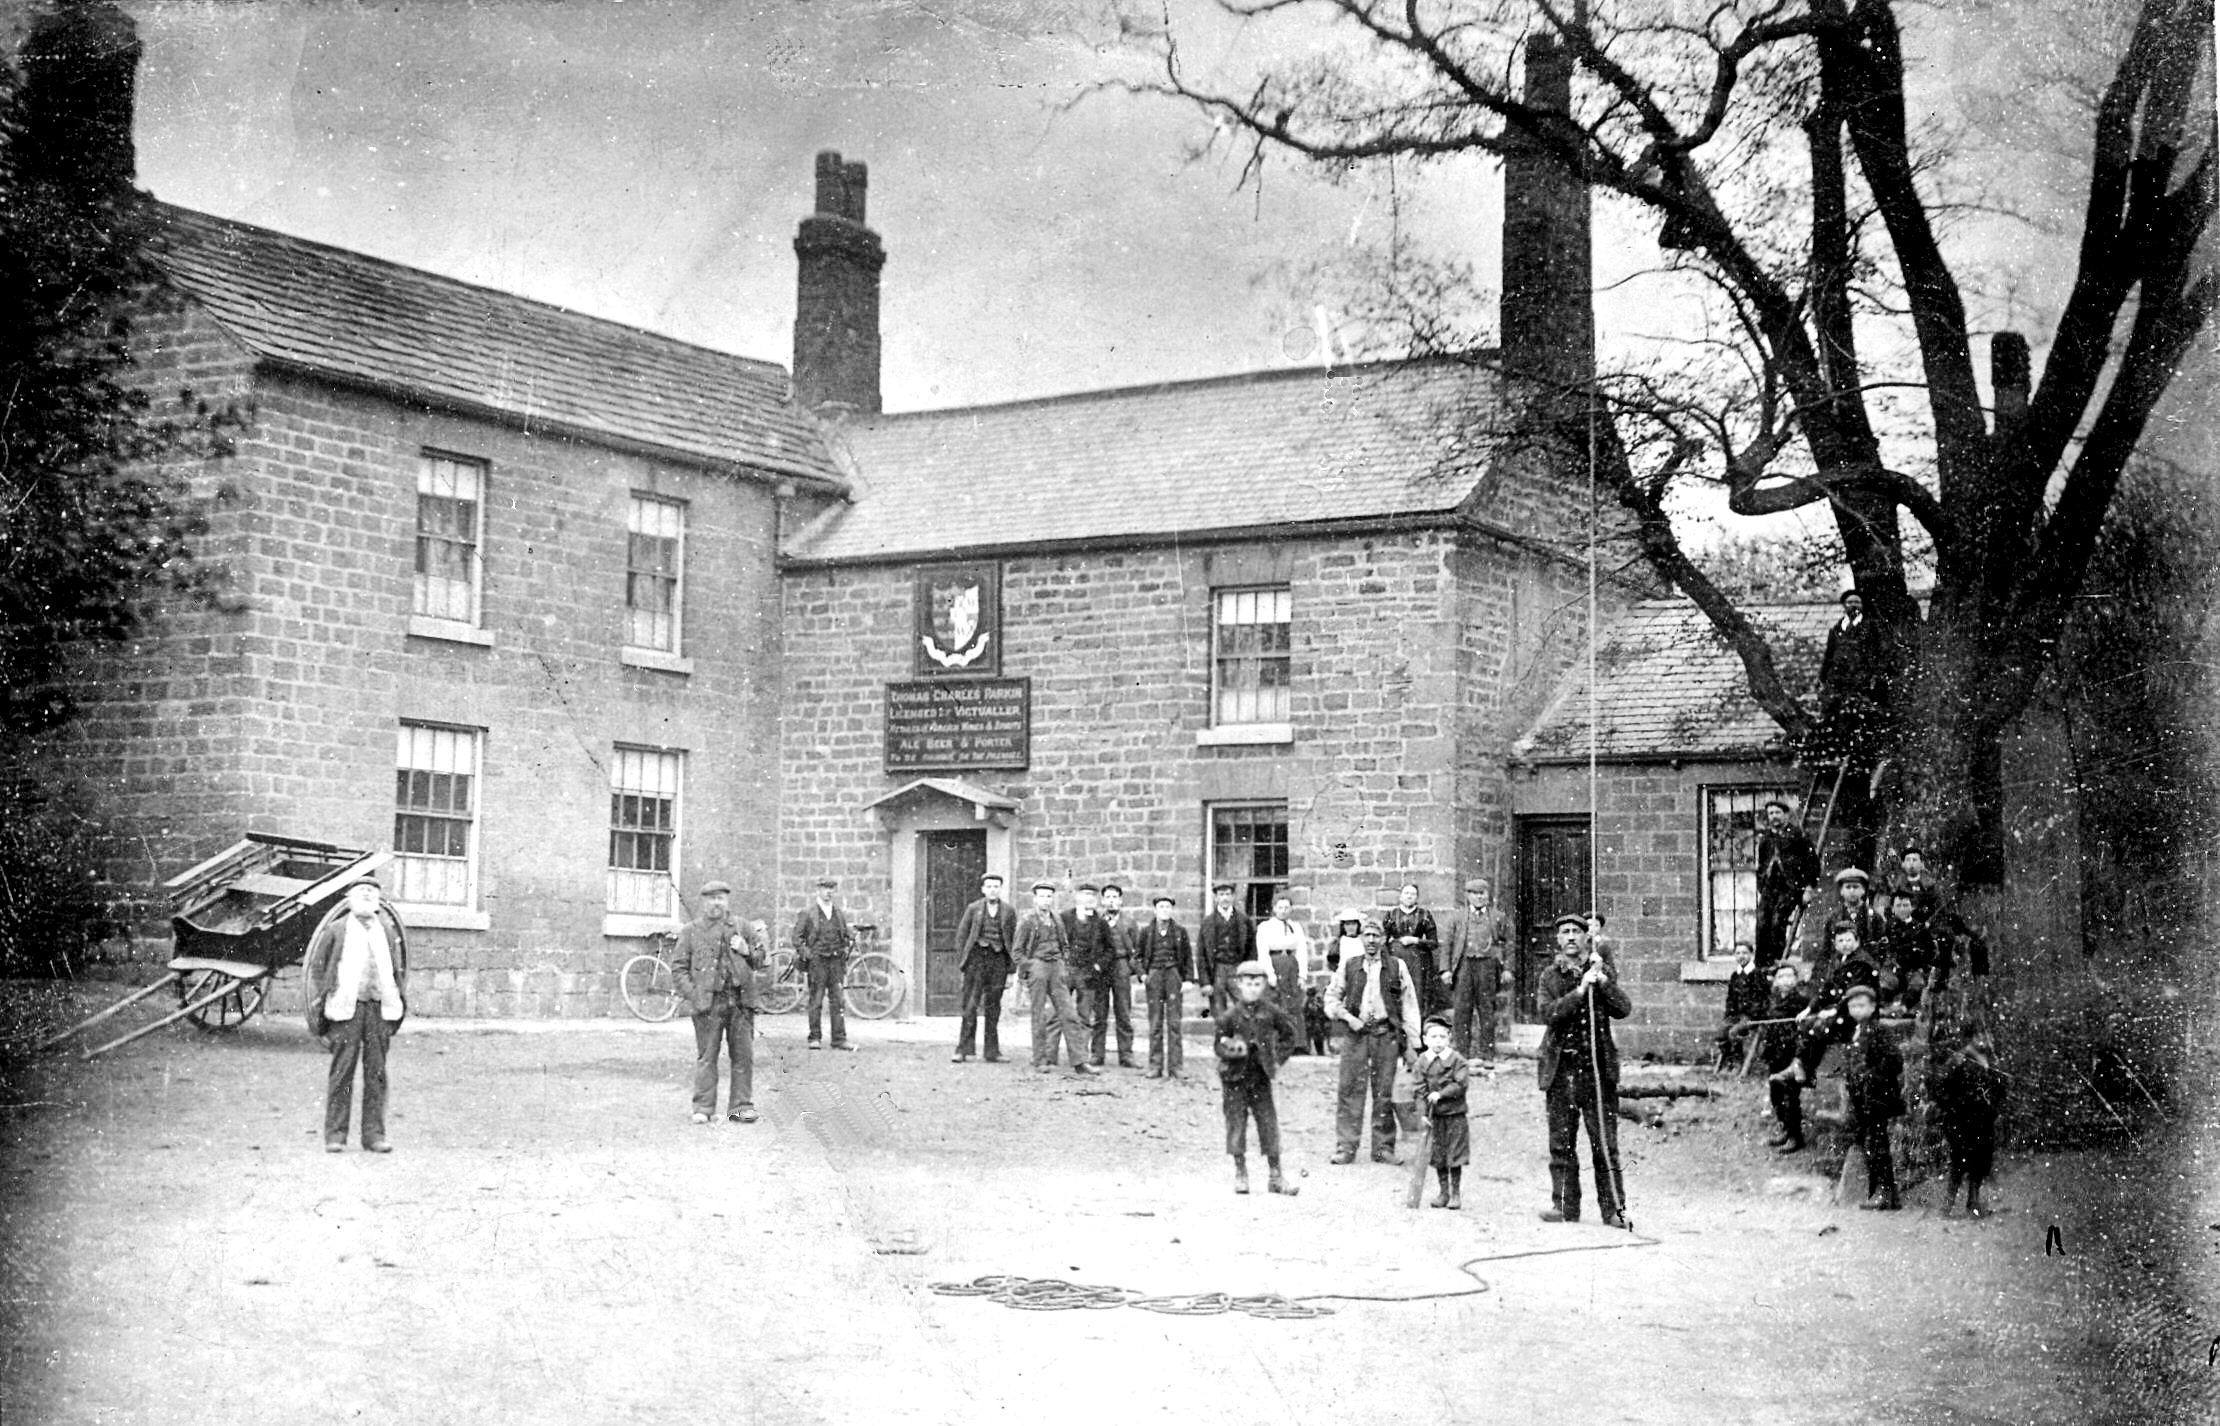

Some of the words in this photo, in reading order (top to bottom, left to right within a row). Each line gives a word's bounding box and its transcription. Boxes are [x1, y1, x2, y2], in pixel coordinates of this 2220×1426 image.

[891, 691, 930, 703] THOMAS
[933, 689, 981, 702] CHARLES
[983, 687, 1023, 700] PARKIN
[899, 739, 920, 750] ALE
[926, 738, 953, 750] BEER
[959, 737, 969, 750] &
[973, 737, 1014, 750] PORTER
